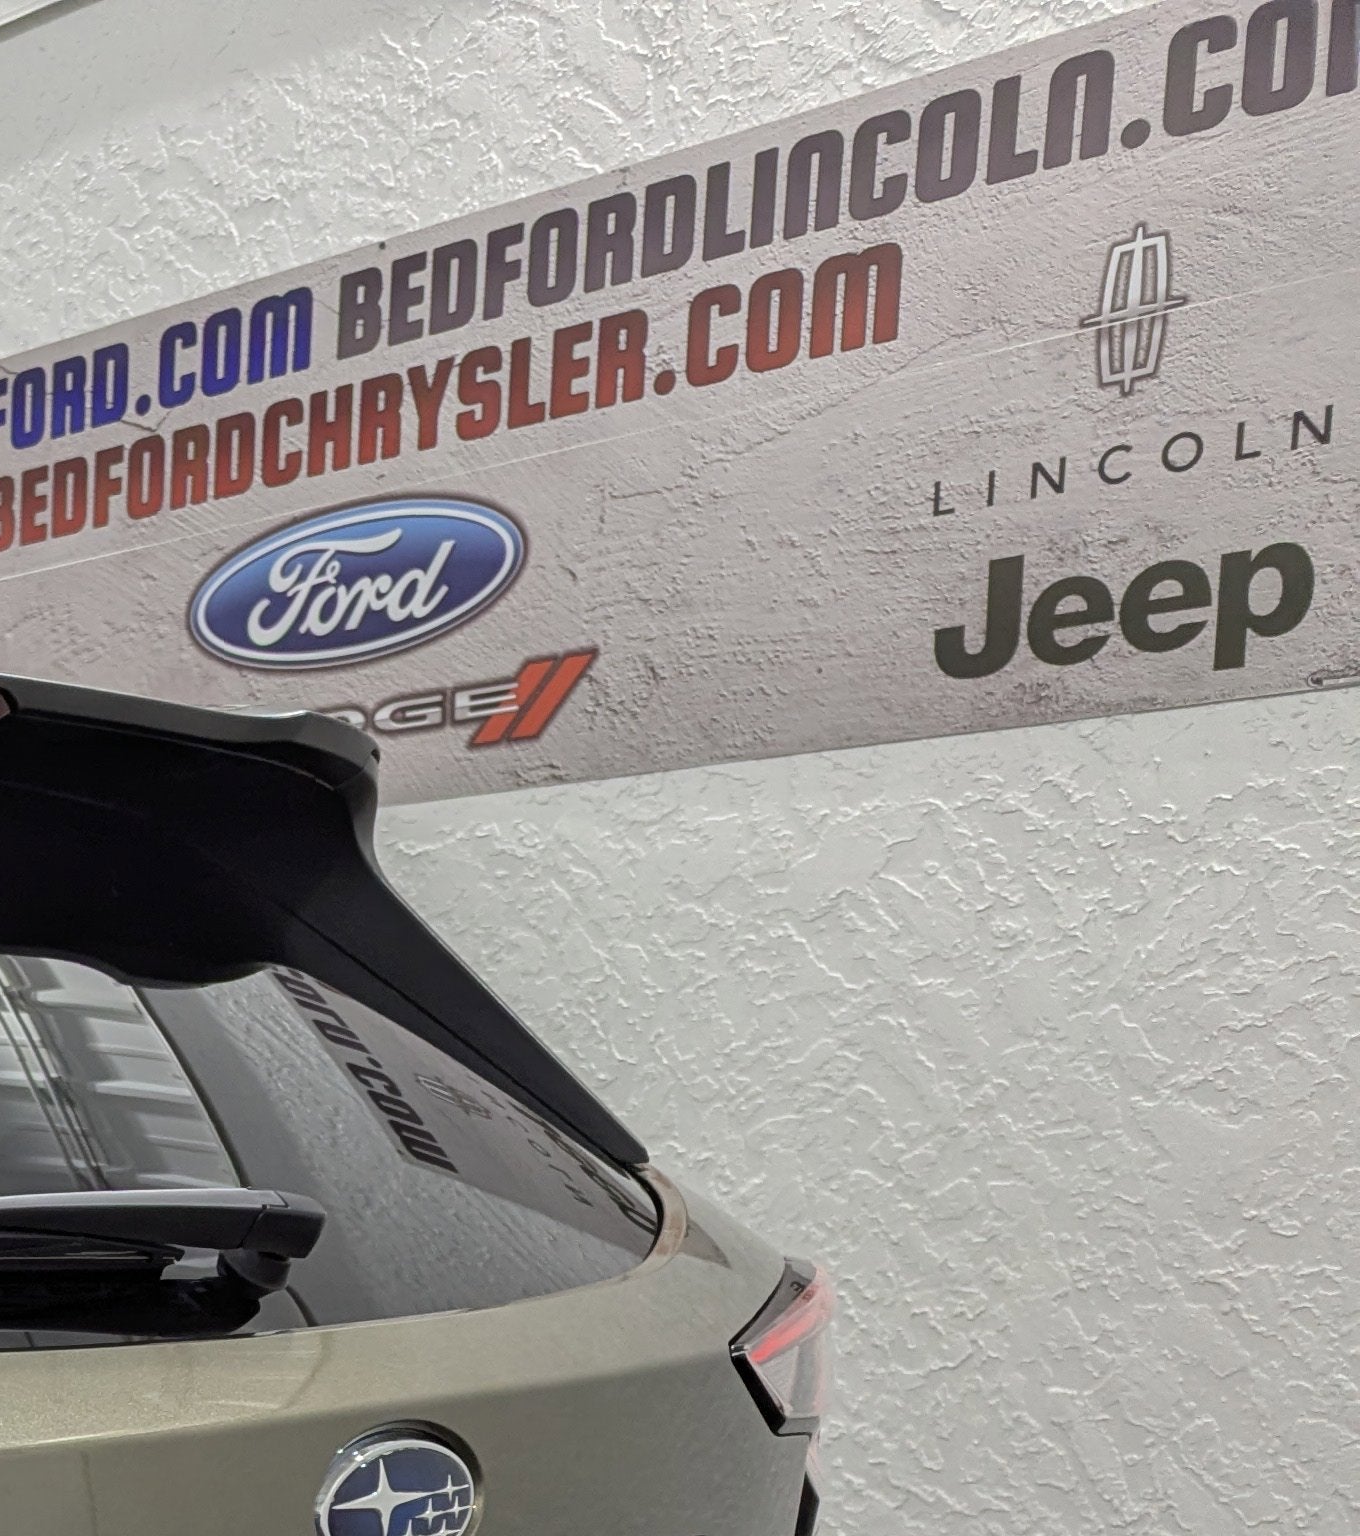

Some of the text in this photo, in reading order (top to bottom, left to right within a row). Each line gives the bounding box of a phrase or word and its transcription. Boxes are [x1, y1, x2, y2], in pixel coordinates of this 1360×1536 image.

[933, 404, 1334, 516] LINCOLN
[246, 527, 458, 648] Ford
[933, 541, 1316, 681] Jeep
